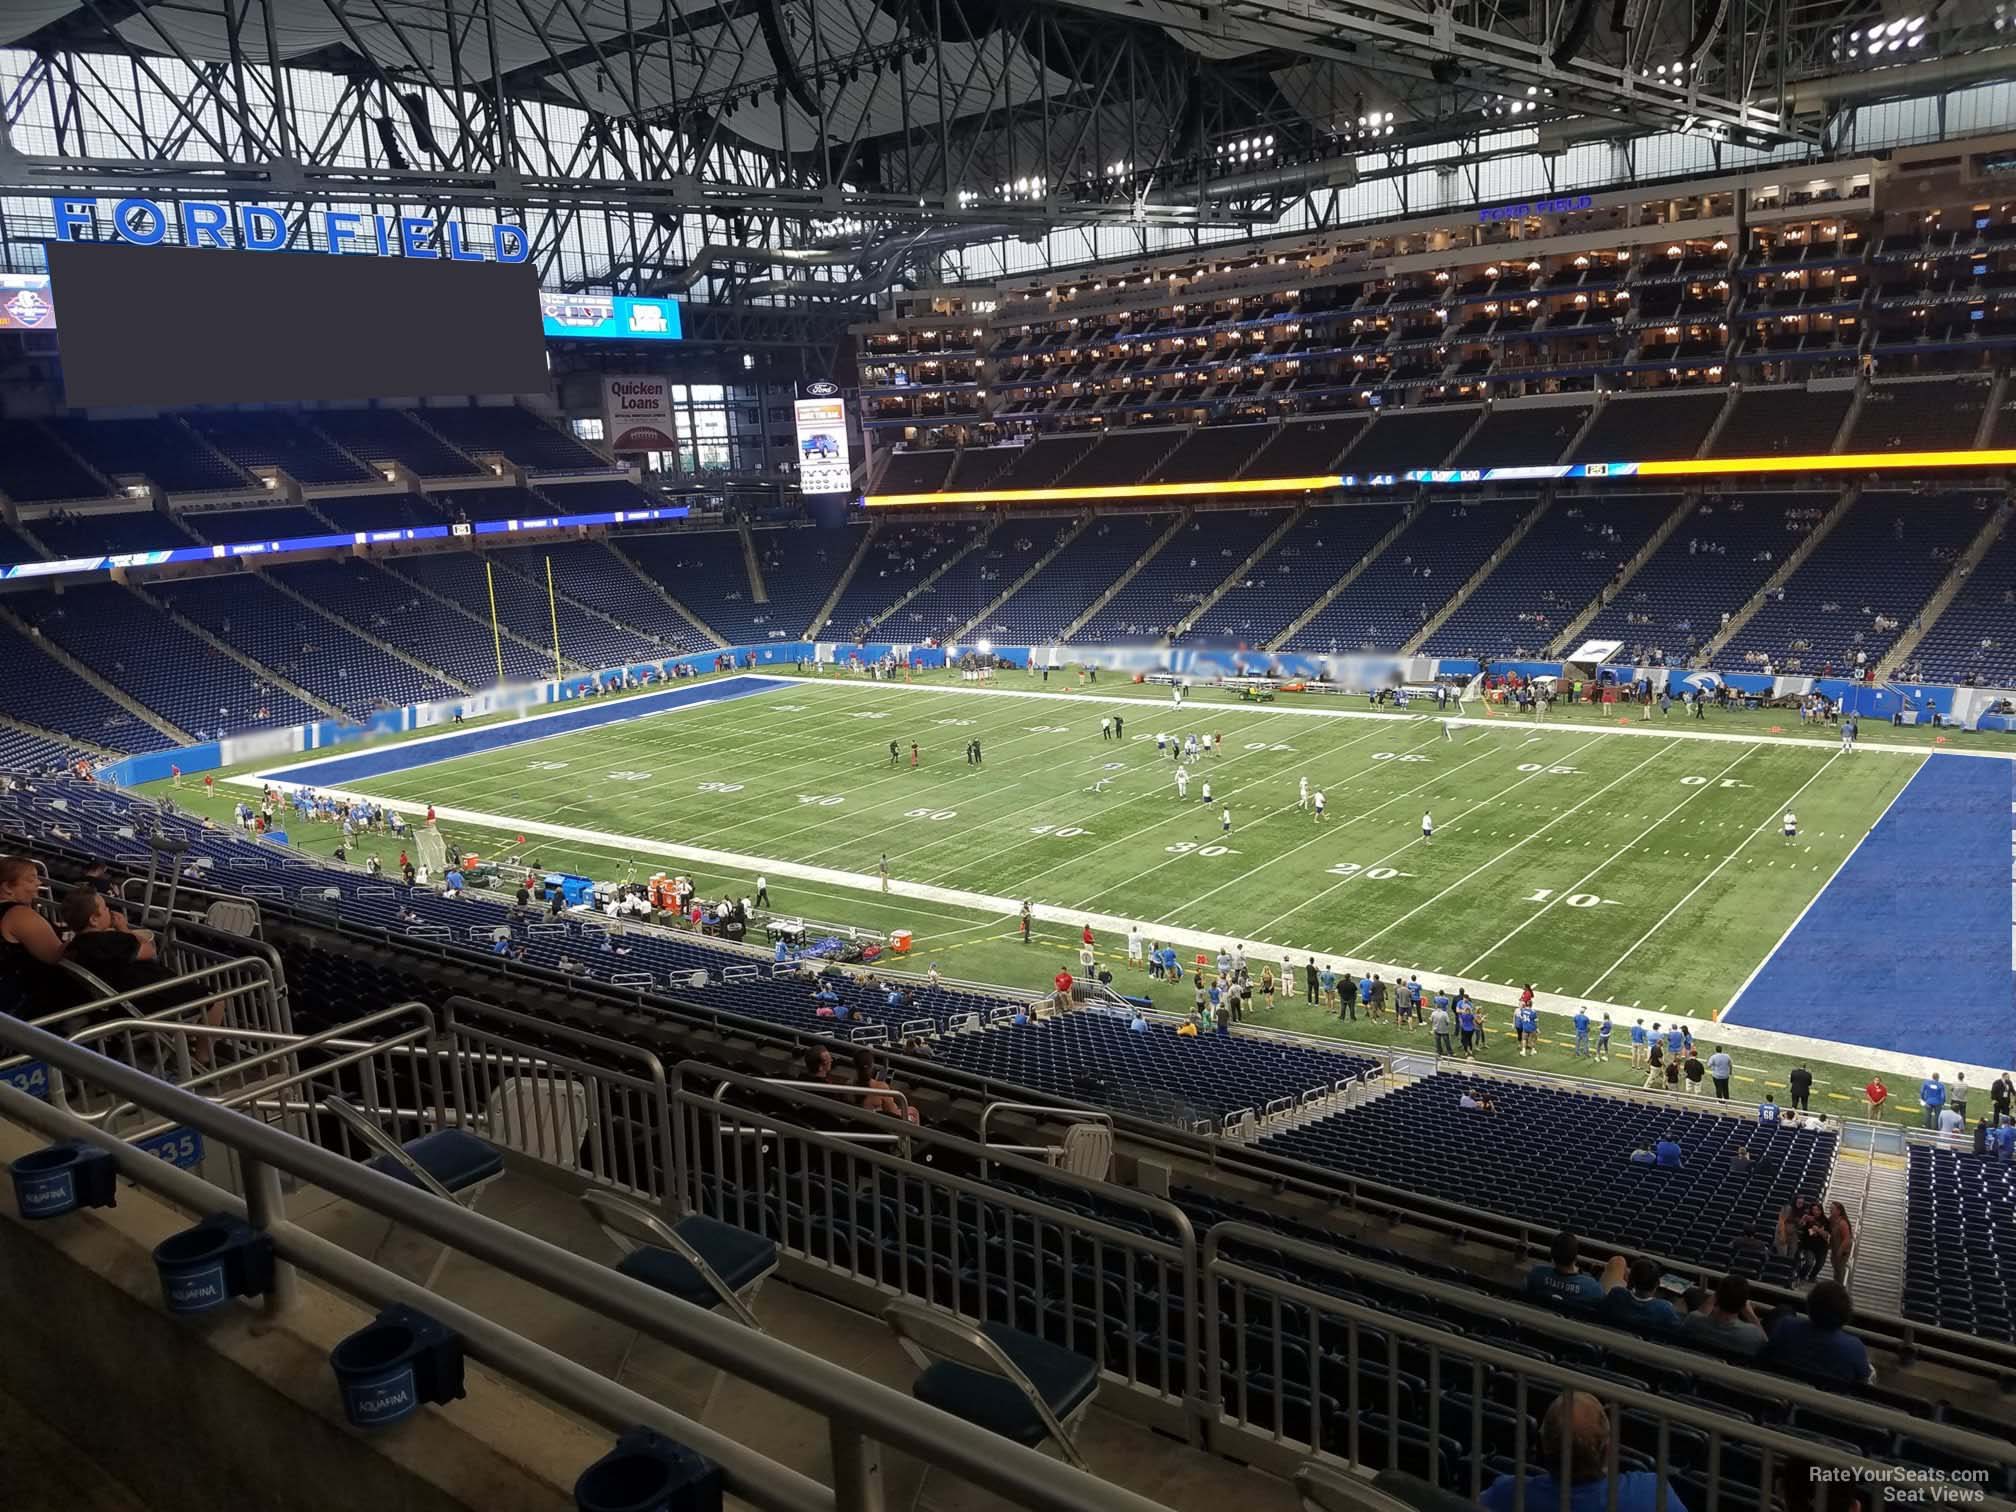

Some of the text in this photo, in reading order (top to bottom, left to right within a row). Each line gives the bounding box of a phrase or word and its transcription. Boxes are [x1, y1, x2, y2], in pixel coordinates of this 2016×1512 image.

[1480, 195, 1592, 221] FORD FIELD
[52, 197, 529, 264] FORD FIELD
[611, 382, 663, 397] Quicken
[621, 396, 660, 409] Loans
[1165, 841, 1230, 857] 30
[1325, 862, 1400, 880] 20
[1521, 888, 1601, 908] 10
[1, 1068, 46, 1092] 34
[359, 1389, 408, 1412] AQUAFINA
